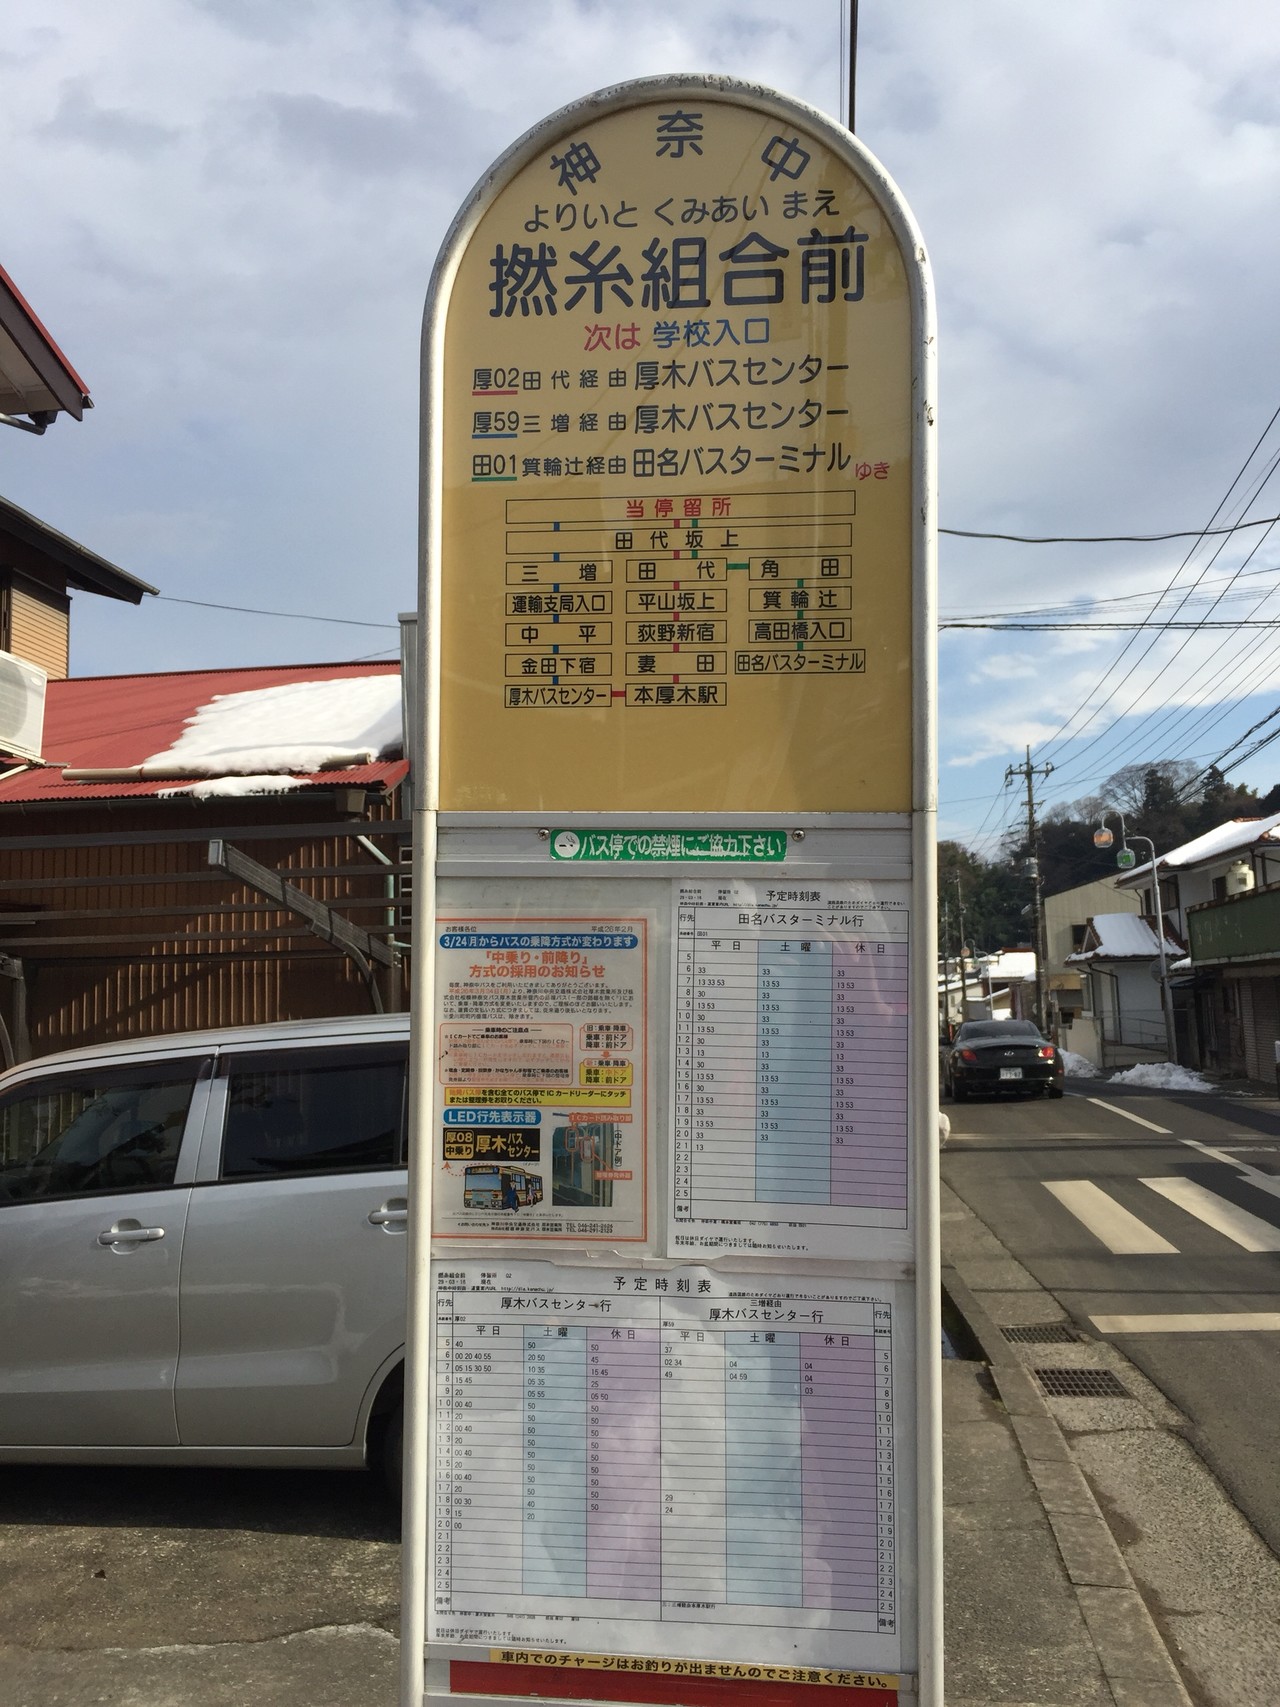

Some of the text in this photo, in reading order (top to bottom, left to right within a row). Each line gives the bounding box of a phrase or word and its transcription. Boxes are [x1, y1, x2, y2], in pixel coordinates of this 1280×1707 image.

[550, 110, 811, 195] 神奈中
[524, 189, 840, 232] よりいと くみあい まえ
[488, 226, 869, 317] 撚糸組合前
[584, 319, 770, 352] 次は 学校入口
[472, 354, 850, 392] 厚02 田代経由 厚木バスセンター
[472, 399, 850, 435] 厚59 三増経由 厚木バスセンター
[472, 443, 890, 481] 田01 箕輪辻経由 田名バスターミナル ゆき
[626, 497, 732, 517] 当停留所
[615, 530, 740, 550] 田代坂上
[521, 563, 597, 581] 三増
[638, 561, 715, 580] 田代
[761, 558, 840, 577] 角田
[512, 595, 606, 613] 運輸支局入口
[638, 592, 715, 611] 平山坂上
[763, 590, 838, 609] 箕輪辻
[521, 626, 597, 643] 中平
[637, 622, 715, 642] 荻野新宿
[754, 621, 846, 640] 高田橋入口
[521, 657, 596, 675] 金田下宿
[638, 654, 715, 673] 妻田
[737, 653, 863, 672] 田名バスターミナル
[509, 688, 607, 706] 厚木バスセンター
[634, 685, 718, 705] 本厚木駅
[766, 890, 821, 902] 予定時刻表
[679, 912, 864, 928] 行先 田名バスターミナル行
[711, 940, 885, 953] 平日 土曜 休日
[469, 965, 606, 978] 方式の採用のお知らせ
[448, 1111, 537, 1123] LED行先表示器
[446, 1132, 473, 1142] 厚08
[476, 1135, 507, 1153] 厚木
[507, 1133, 523, 1144] バス
[446, 1145, 473, 1155] 中乗り
[507, 1146, 539, 1158] センター
[613, 1277, 712, 1293] 予定時刻表
[438, 1297, 612, 1312] 行先 厚木バスセンター行
[750, 1299, 782, 1308] 三増経由
[709, 1308, 891, 1323] 厚木バスセンター行 行先
[476, 1326, 635, 1340] 平日 土曜 休日
[680, 1331, 849, 1346] 平日 土曜 休日
[879, 1618, 894, 1627] 備考
[501, 1650, 887, 1689] 車内でのチャージはお釣りが出ませんのでご注意ください。
